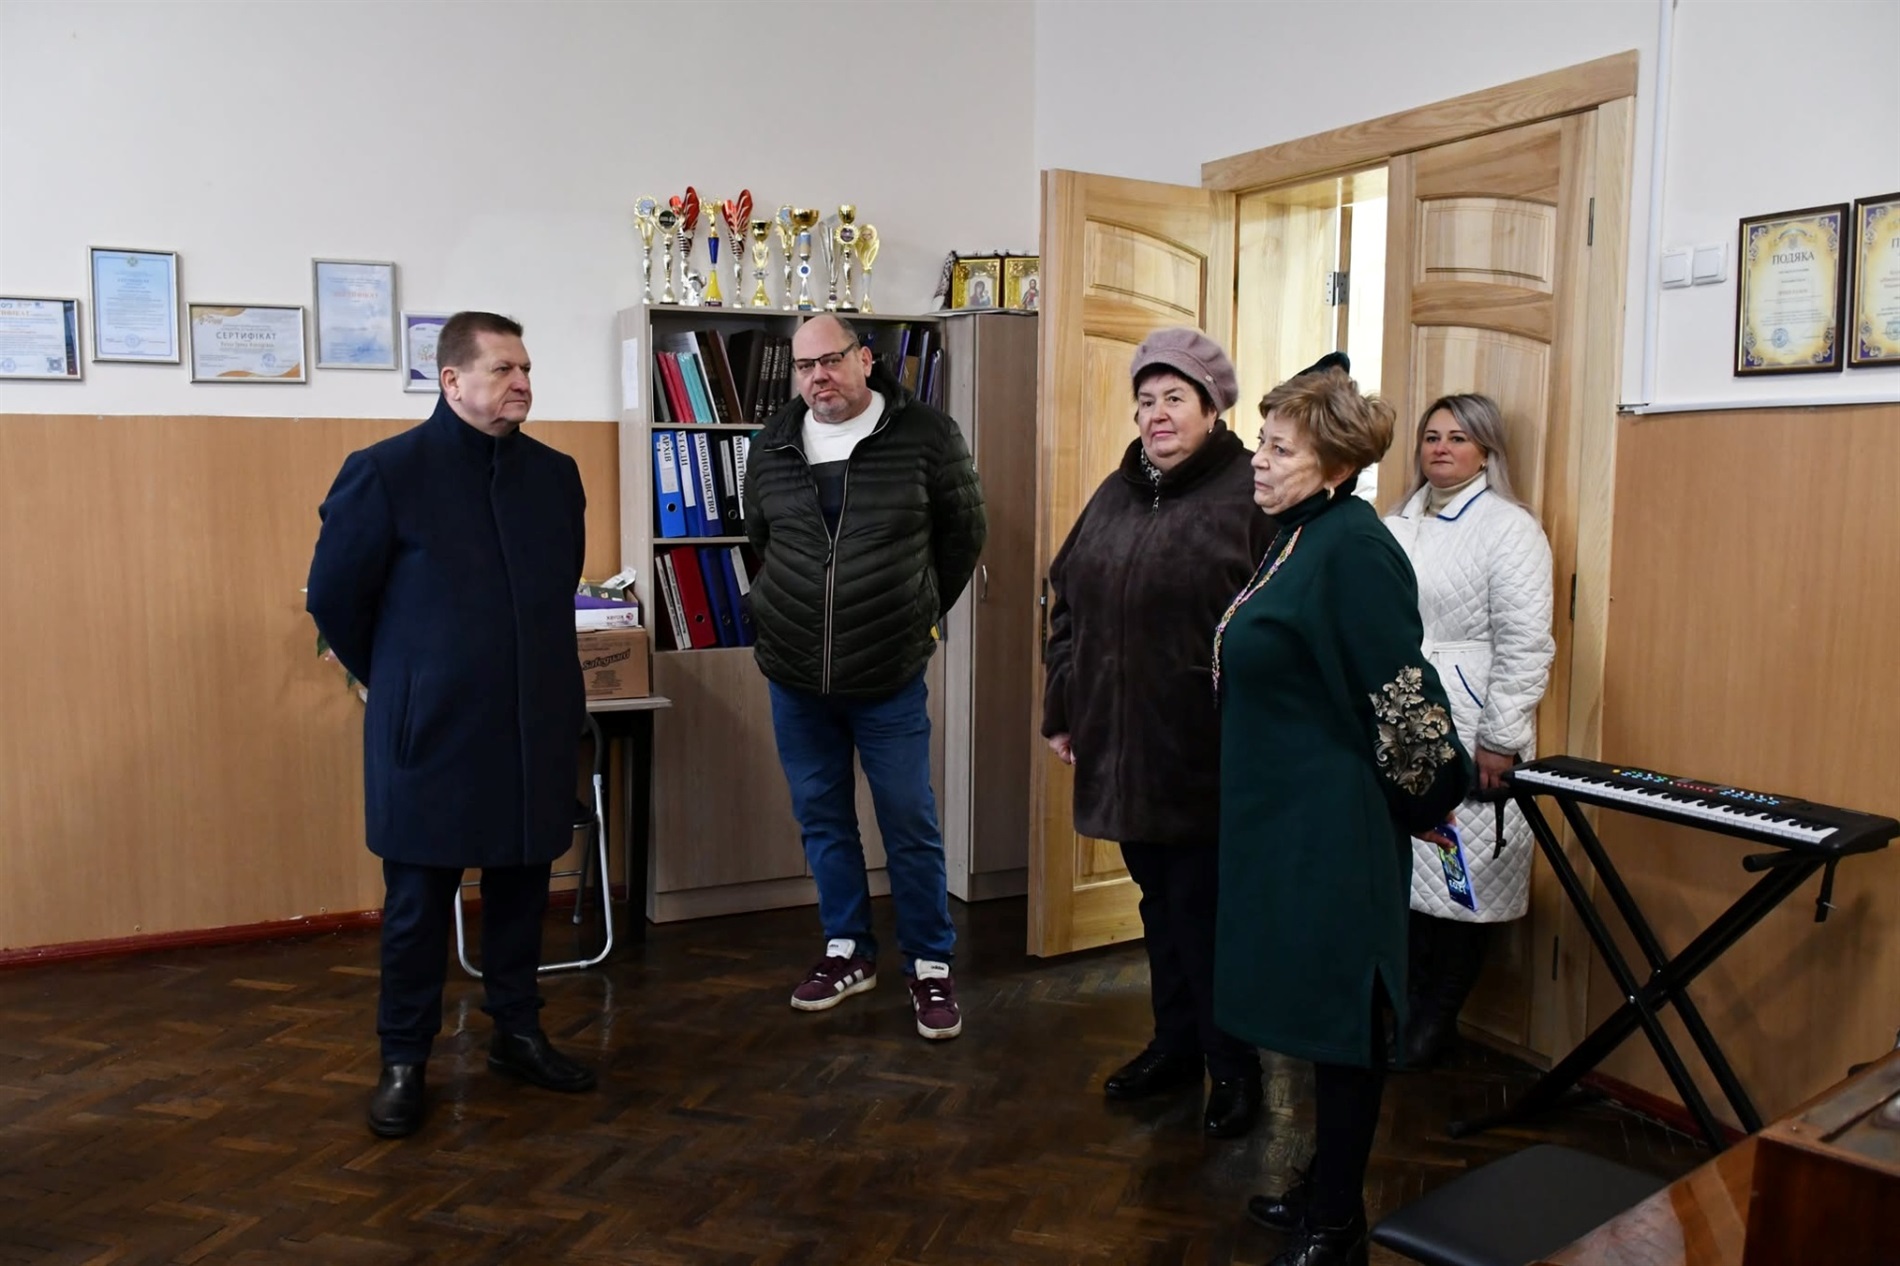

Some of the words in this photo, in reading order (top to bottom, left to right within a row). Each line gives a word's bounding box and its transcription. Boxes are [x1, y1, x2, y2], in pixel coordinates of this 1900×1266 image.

[1772, 251, 1815, 265] ПОДЯКА
[216, 331, 277, 340] СЕРТИФІКАТ
[678, 431, 689, 466] УГОДИ
[698, 433, 716, 513] ЗАКОНОДАВСТВО
